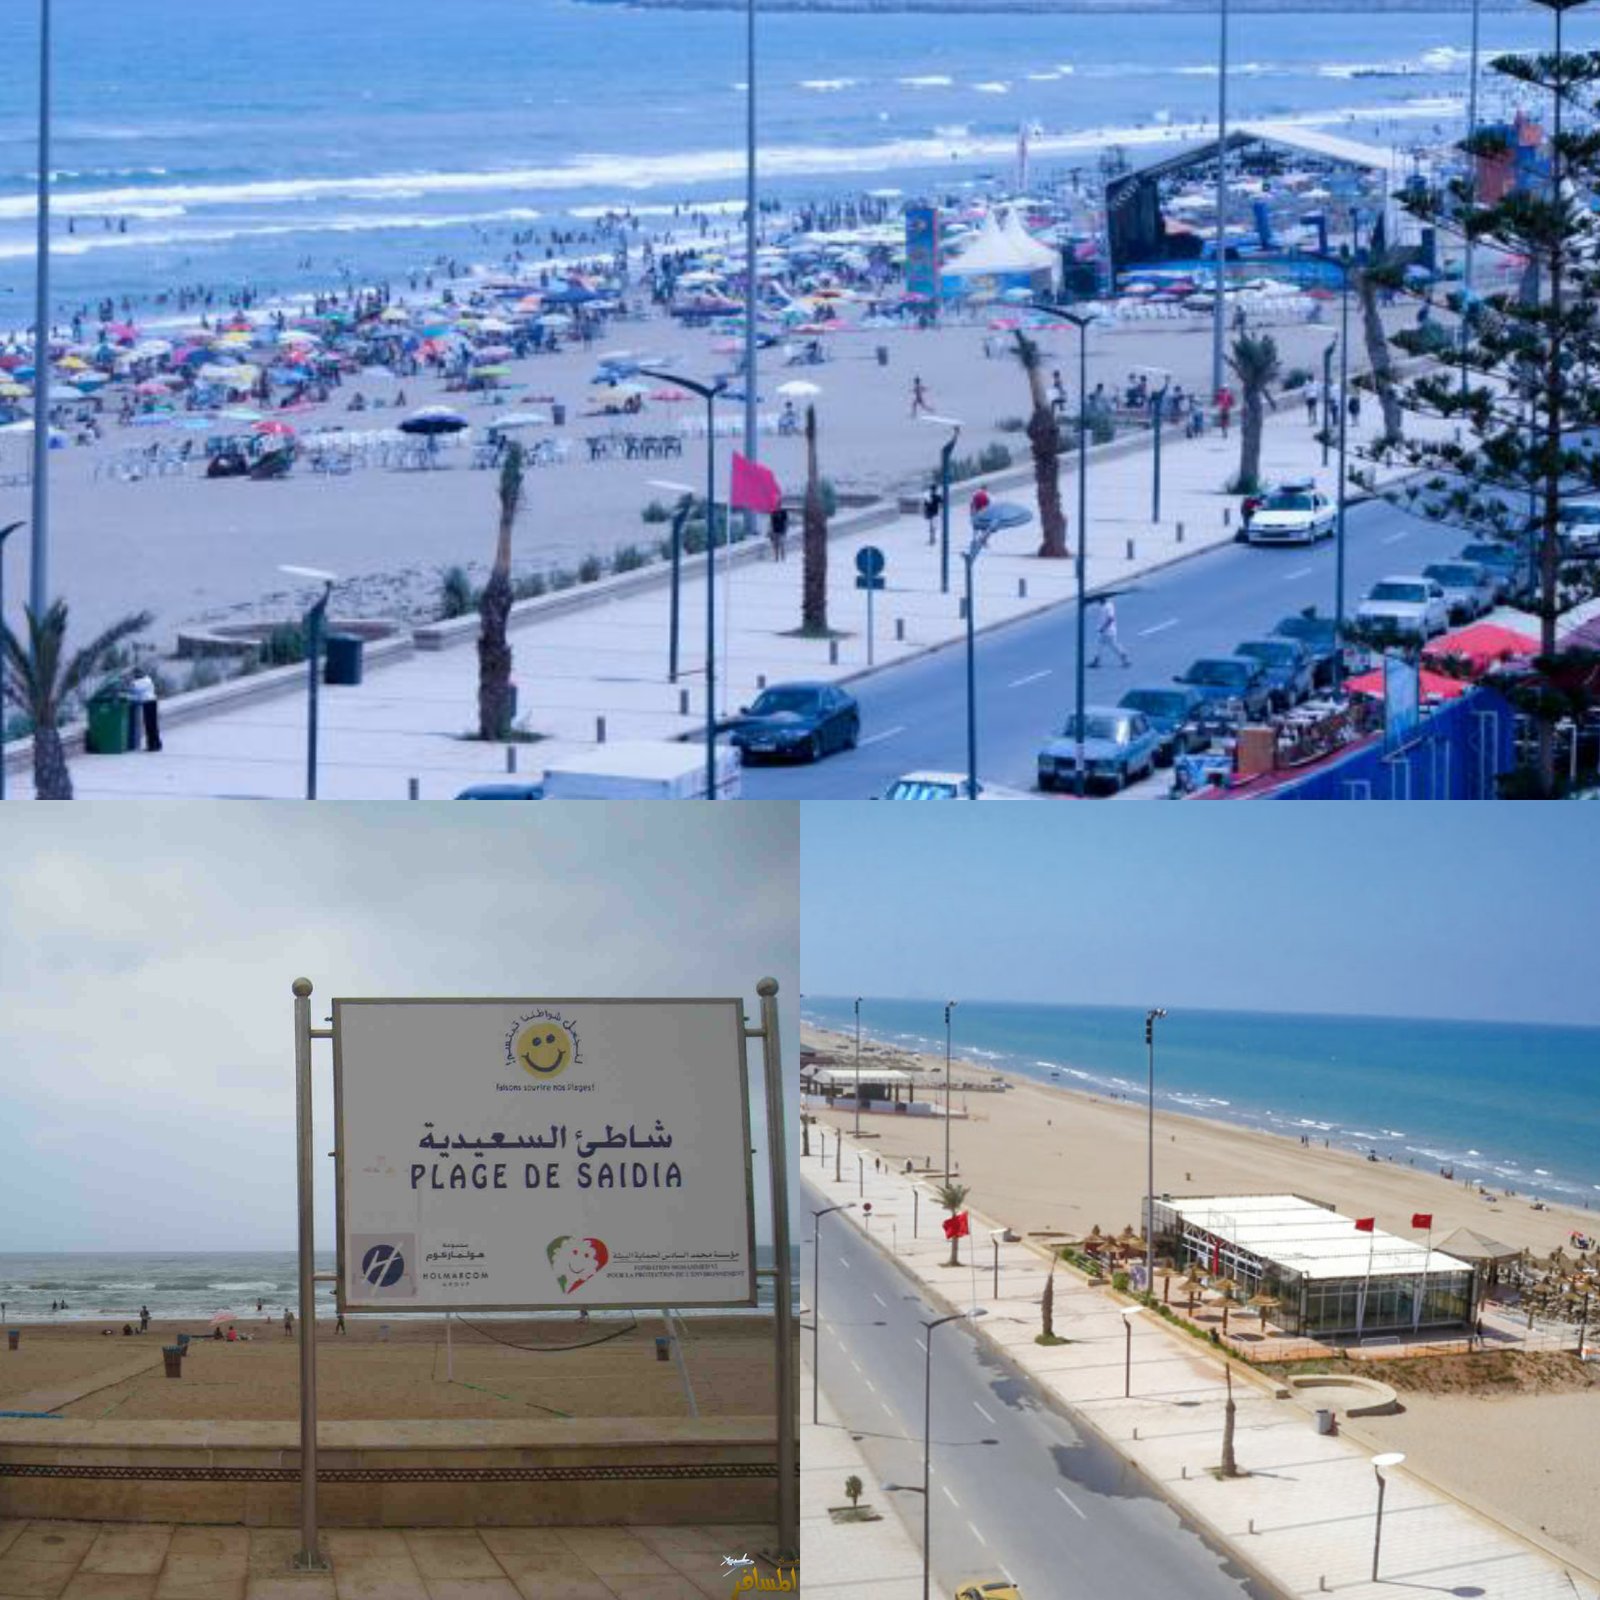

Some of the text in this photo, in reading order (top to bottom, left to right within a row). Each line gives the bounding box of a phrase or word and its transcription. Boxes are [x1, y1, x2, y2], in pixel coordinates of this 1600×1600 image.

[419, 1119, 672, 1158] شاطئ السعيدية
[411, 1162, 682, 1189] PLAGE DE SAIDIA
